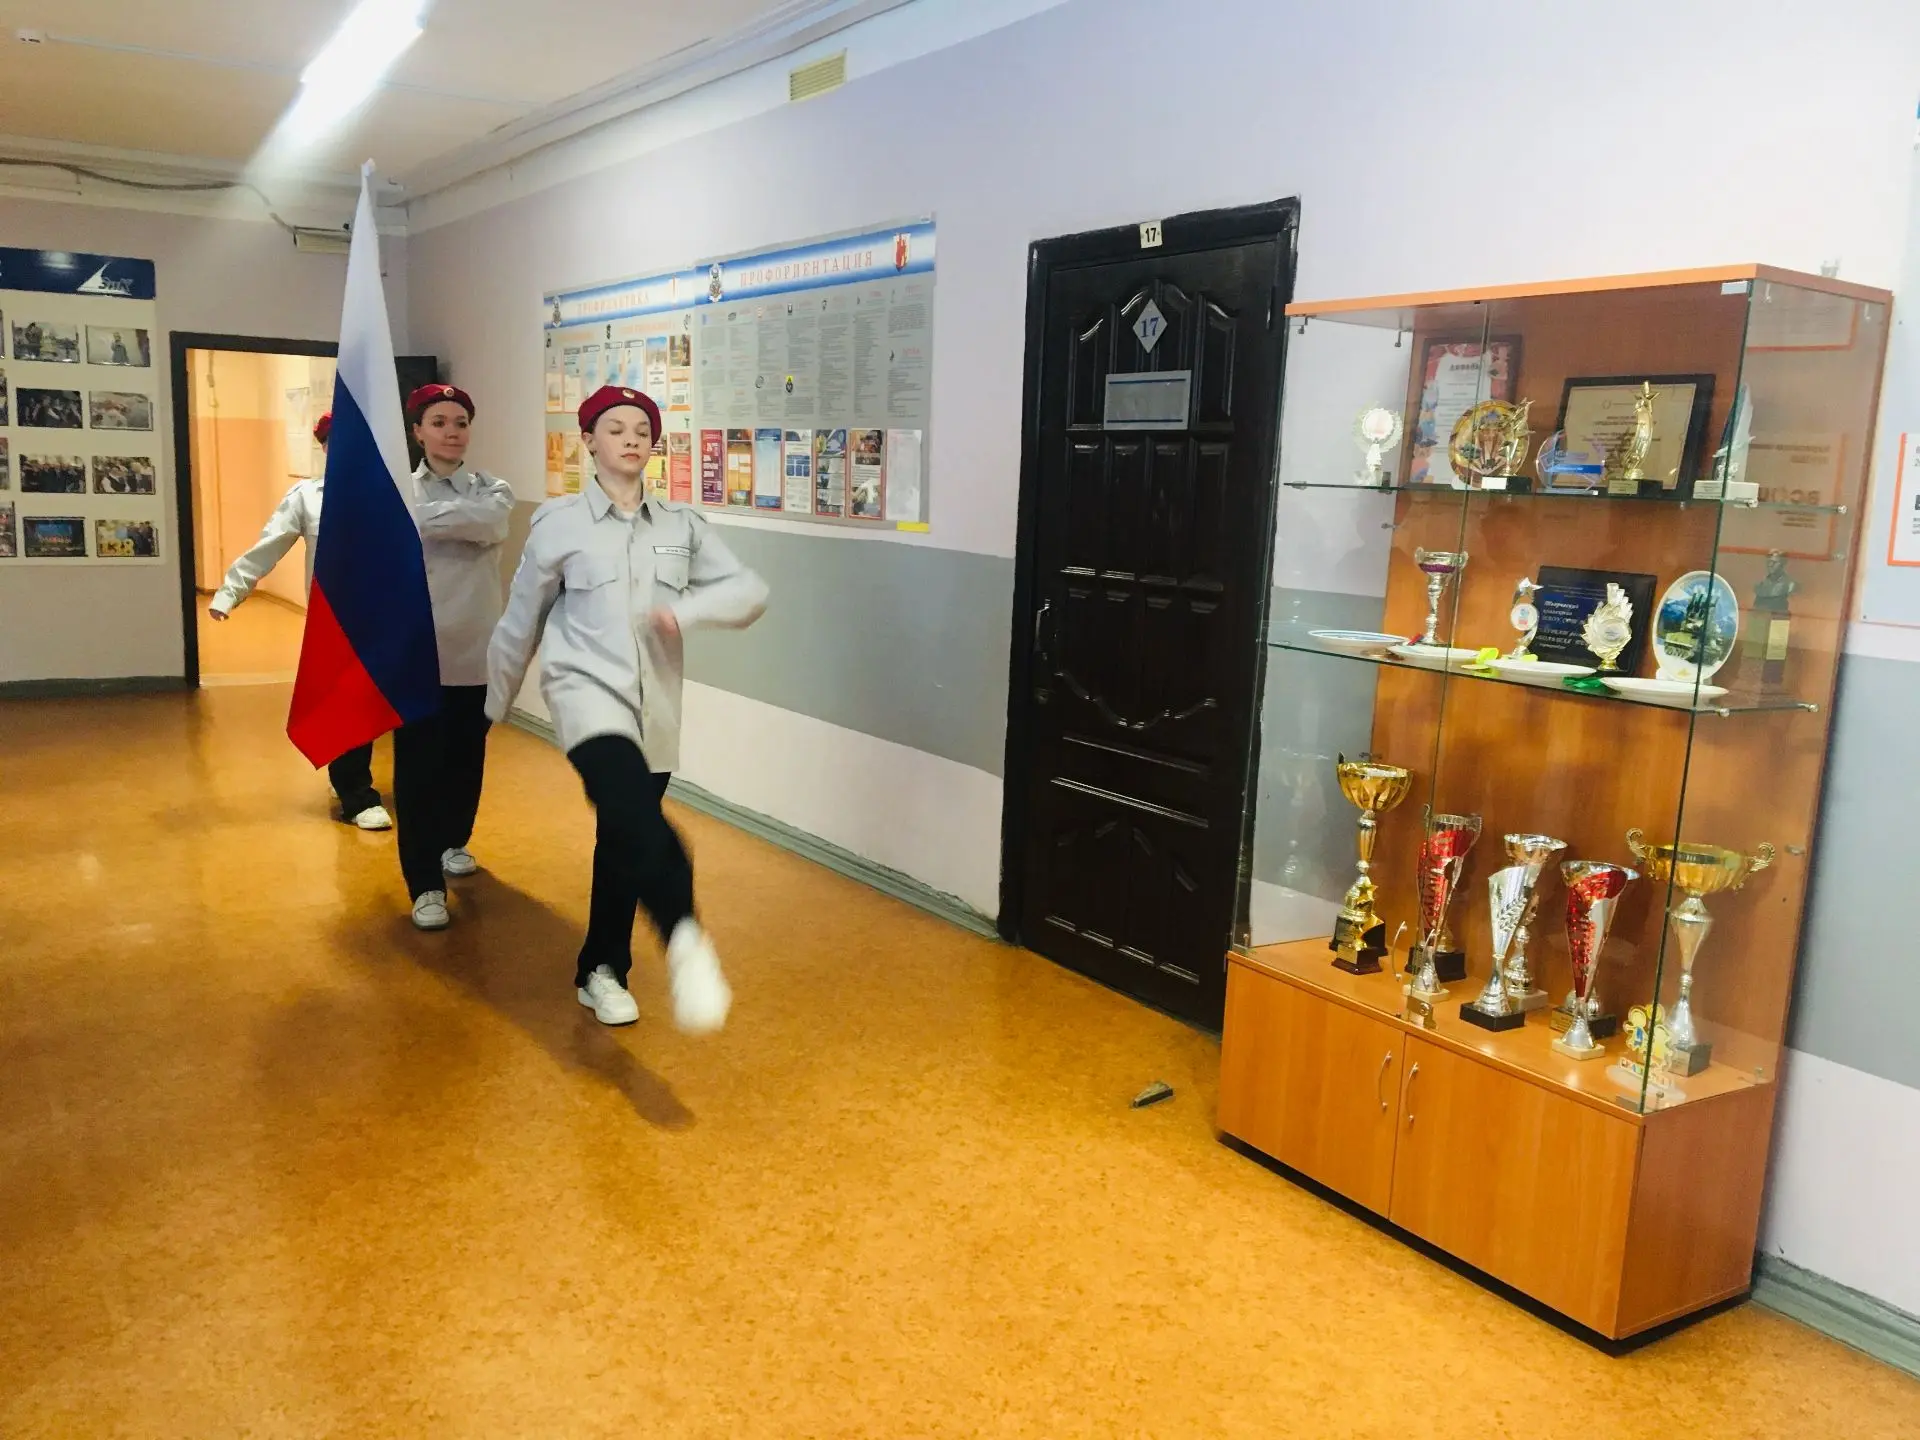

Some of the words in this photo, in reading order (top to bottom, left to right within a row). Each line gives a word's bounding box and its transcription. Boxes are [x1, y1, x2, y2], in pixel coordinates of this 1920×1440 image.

[1145, 227, 1157, 243] 17
[740, 251, 872, 288] ПРОФОРИЕНТАЦИЯ
[1140, 317, 1160, 338] 17
